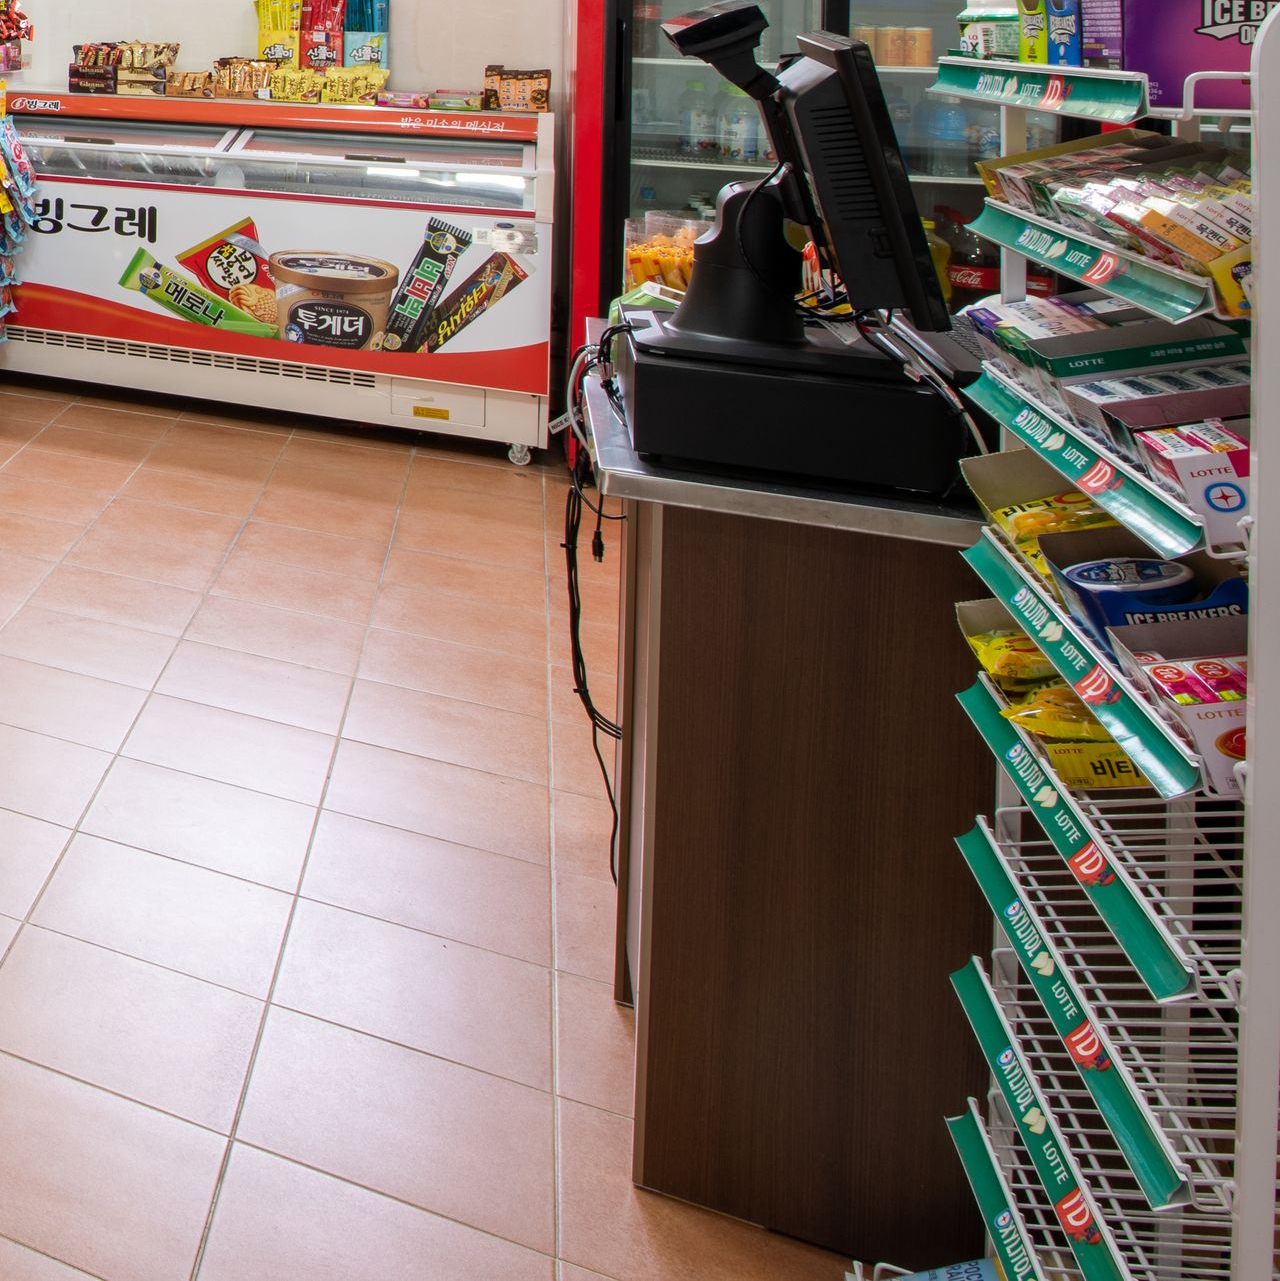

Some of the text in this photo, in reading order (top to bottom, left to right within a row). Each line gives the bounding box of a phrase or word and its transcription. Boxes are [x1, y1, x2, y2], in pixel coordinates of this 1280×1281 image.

[26, 97, 61, 112] 빙그레
[399, 115, 424, 131] 밝은
[425, 117, 461, 132] 미소의
[31, 197, 158, 244] 빙그레
[1026, 226, 1052, 258] XYLITOL
[164, 276, 225, 328] 메로나
[313, 305, 350, 316] SINCE 1974
[295, 308, 365, 338] 투게더
[1021, 592, 1046, 635] XYLITOL
[1015, 748, 1046, 795] XYLITOL
